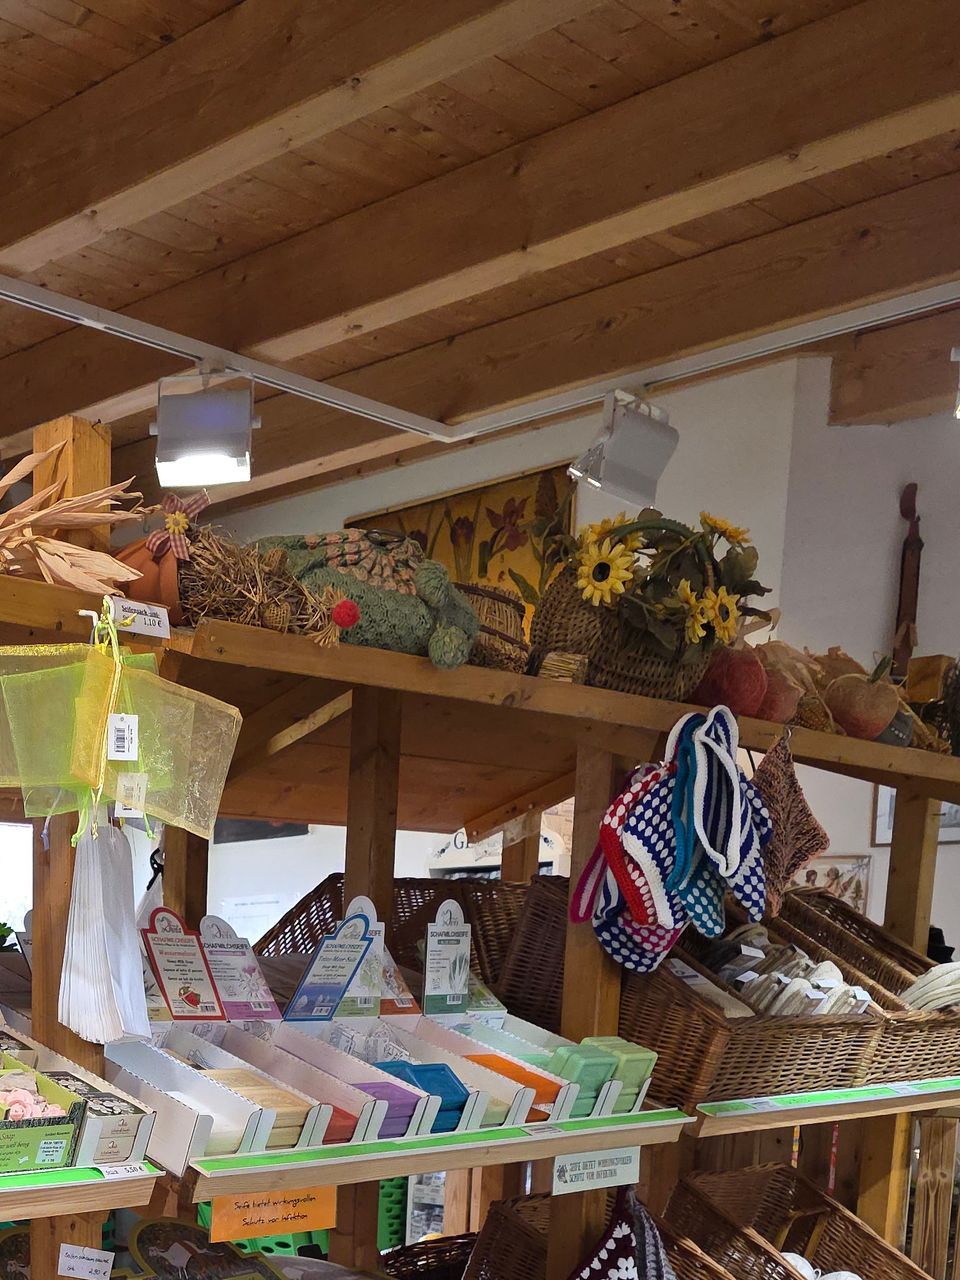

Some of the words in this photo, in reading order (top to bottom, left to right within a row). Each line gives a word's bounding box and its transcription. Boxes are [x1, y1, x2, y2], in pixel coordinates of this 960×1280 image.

[144, 617, 157, 628] 1,10
[234, 1201, 250, 1210] Seife
[252, 1199, 271, 1208] bietet
[273, 1194, 317, 1208] wirkungsvollen
[242, 1217, 265, 1226] Schutz
[281, 1213, 308, 1222] Infektion
